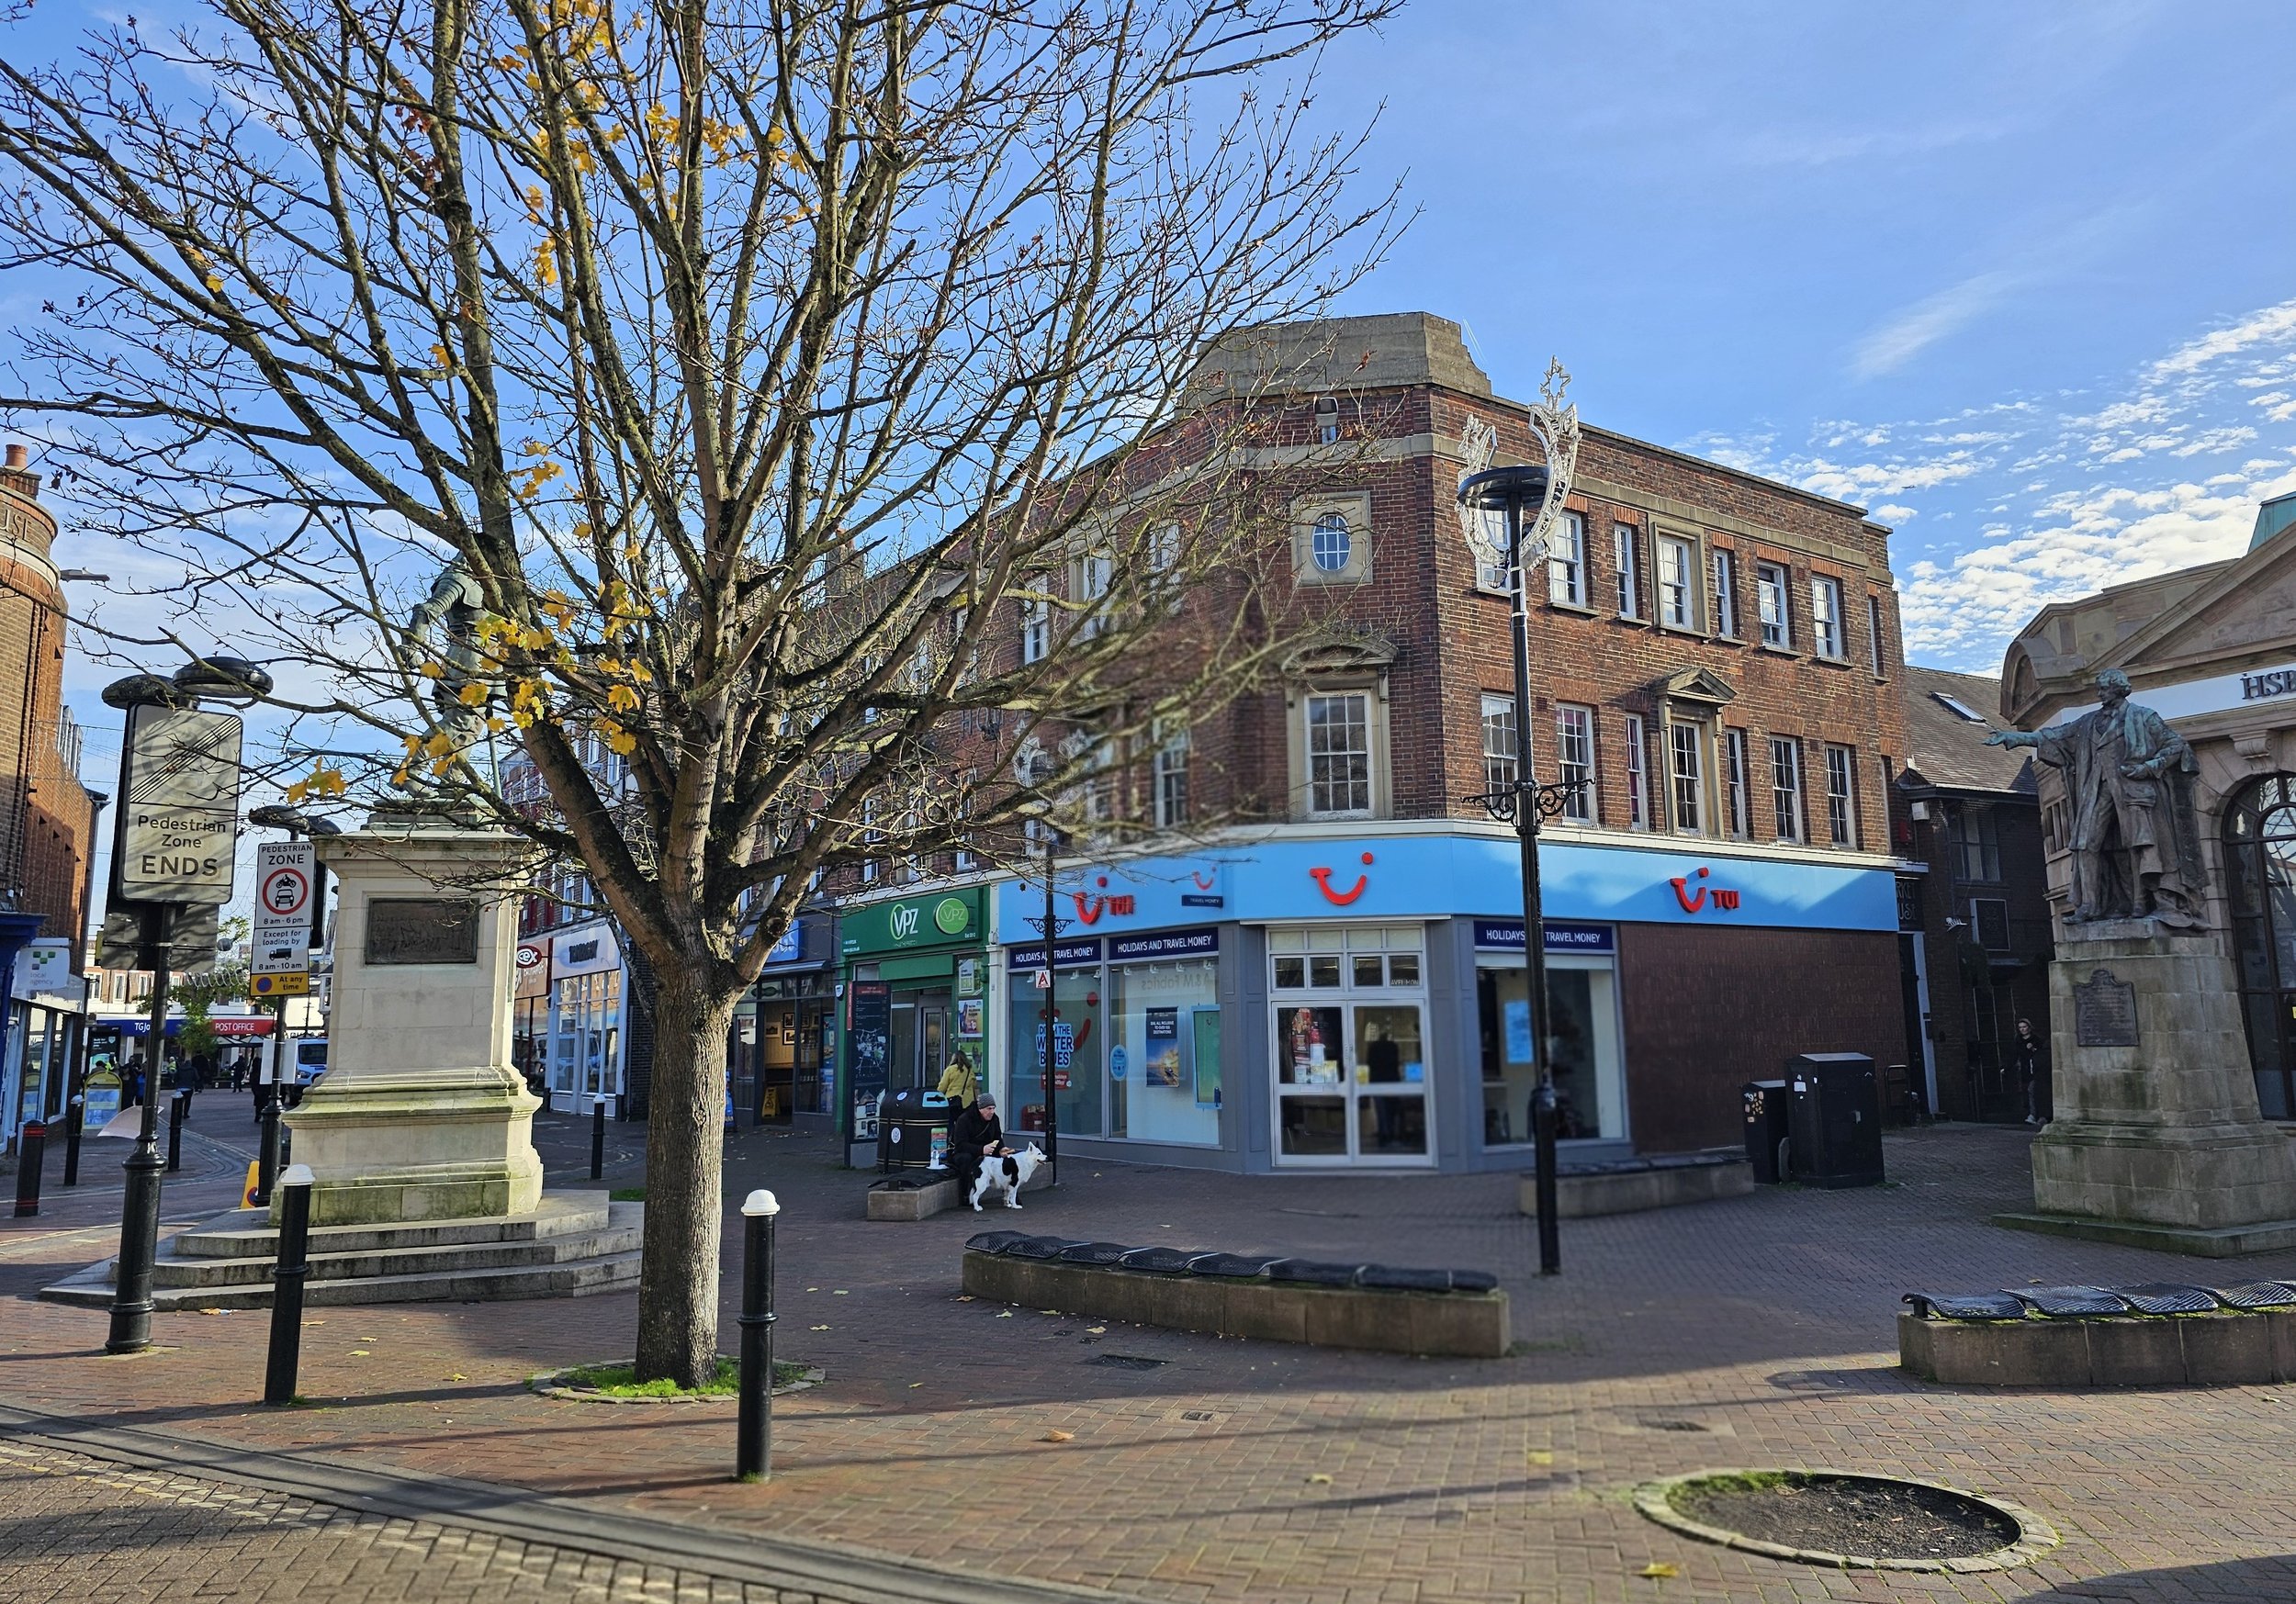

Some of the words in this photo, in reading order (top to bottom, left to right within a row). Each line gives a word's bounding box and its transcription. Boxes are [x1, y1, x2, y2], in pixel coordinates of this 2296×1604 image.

[2240, 670, 2296, 700] HSB
[138, 815, 226, 833] Pedestrian
[162, 834, 202, 848] Zone
[262, 845, 312, 853] PEDESTRIAN
[141, 855, 218, 877] ENDS
[268, 854, 304, 865] ZONE
[1896, 881, 1915, 899] RKET
[1711, 890, 1739, 909] TUI
[943, 907, 964, 921] VPZ
[894, 908, 918, 937] VPZ
[264, 930, 288, 939] Except
[1485, 929, 1526, 941] HOLIDAYS
[1545, 931, 1573, 942] TRAVEL
[1574, 933, 1601, 943] MONEY
[1118, 941, 1148, 953] HOLIDAYS
[1148, 940, 1162, 950] AND
[1163, 937, 1187, 948] TRAVEL
[1187, 935, 1212, 947] MONEY
[1015, 951, 1041, 962] HOLIDAYS
[1053, 948, 1073, 959] TRAVEL
[1074, 947, 1094, 958] MONEY
[134, 1022, 151, 1033] TGJo
[215, 1022, 231, 1031] POST
[232, 1022, 254, 1031] OFFICE
[1058, 1026, 1070, 1035] THE
[1037, 1036, 1073, 1049] WTER
[1041, 1051, 1069, 1065] BES
